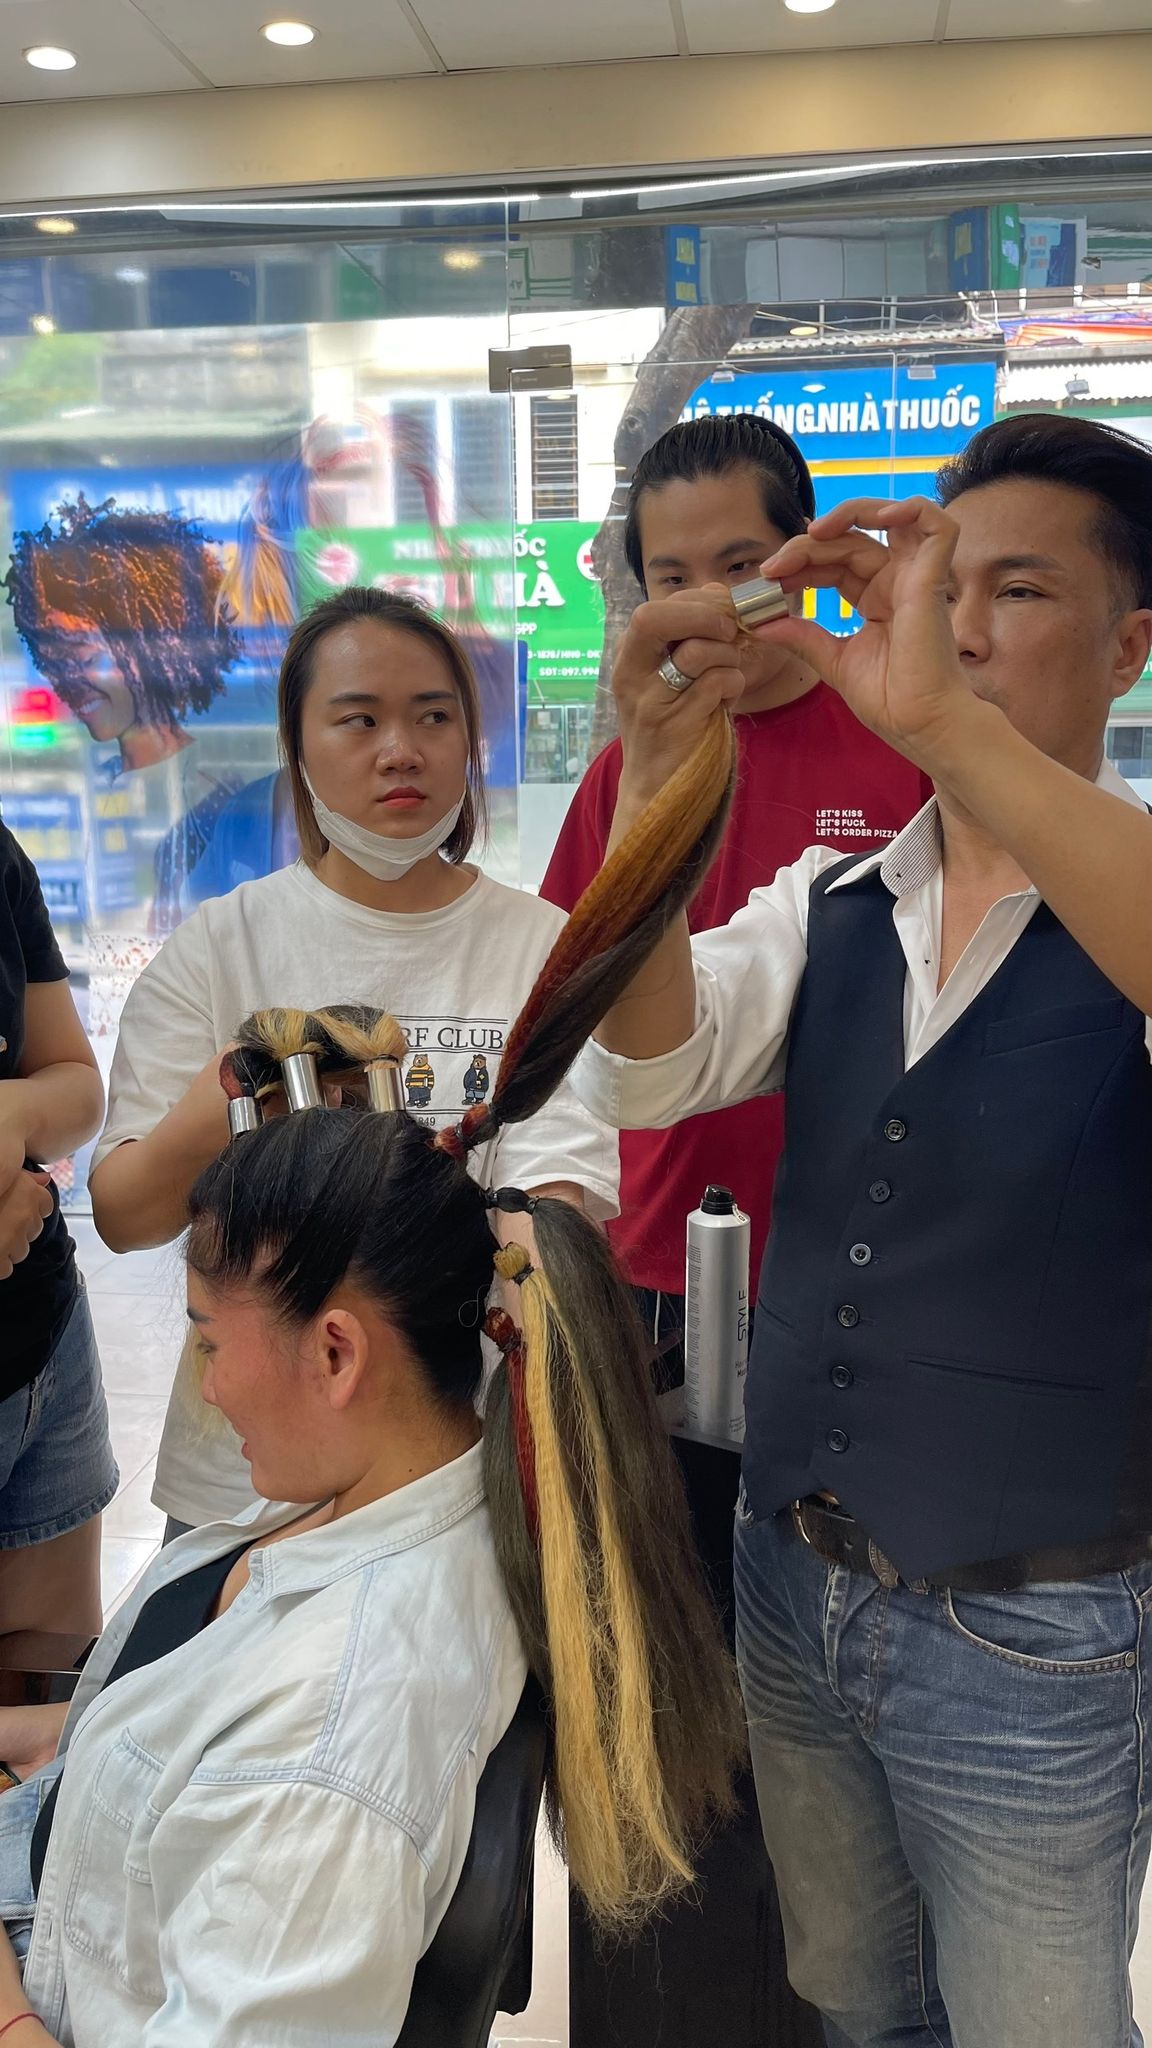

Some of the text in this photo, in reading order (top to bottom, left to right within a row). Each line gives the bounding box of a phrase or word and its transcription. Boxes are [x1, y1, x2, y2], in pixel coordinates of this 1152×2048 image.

[817, 391, 881, 433] NHÀ
[882, 384, 981, 430] THUỐC
[816, 810, 863, 818] LET'S KISS
[816, 819, 866, 827] LET'S FUCK
[841, 829, 872, 837] ORDER
[873, 830, 898, 838] PIZZA
[437, 1027, 503, 1050] CLUB
